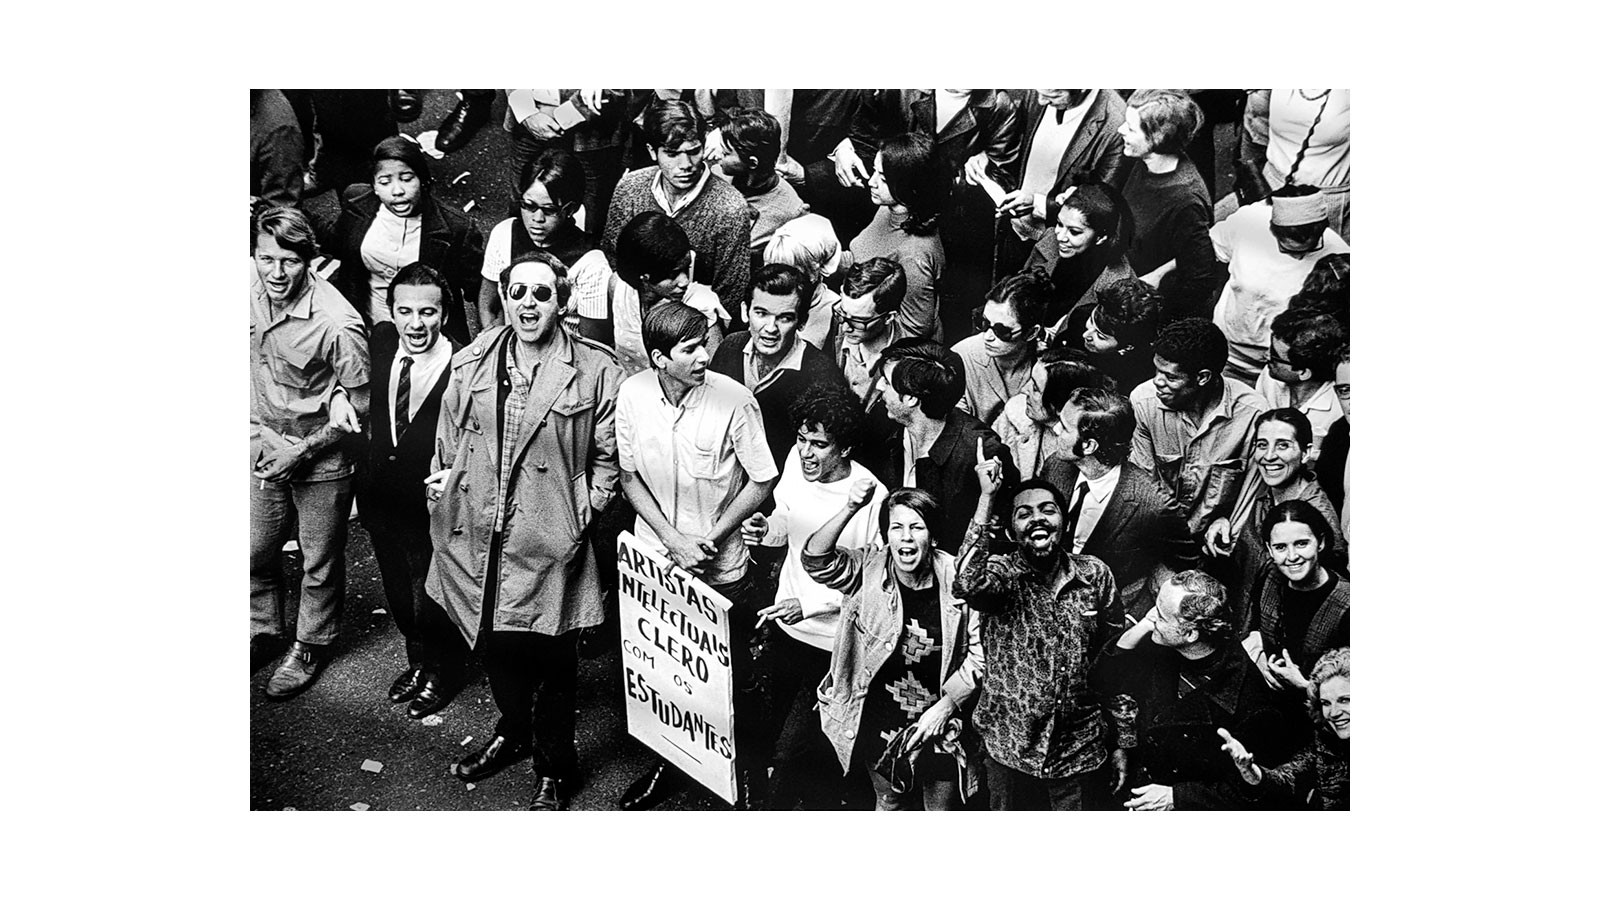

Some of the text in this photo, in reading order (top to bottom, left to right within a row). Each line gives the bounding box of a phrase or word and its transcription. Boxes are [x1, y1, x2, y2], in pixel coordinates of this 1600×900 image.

[618, 542, 717, 624] ARTISTAS
[619, 573, 729, 667] NTELECTUAIS
[623, 640, 693, 695] COM OS
[637, 618, 709, 683] CLERO
[626, 667, 732, 760] ESTUDANTES
